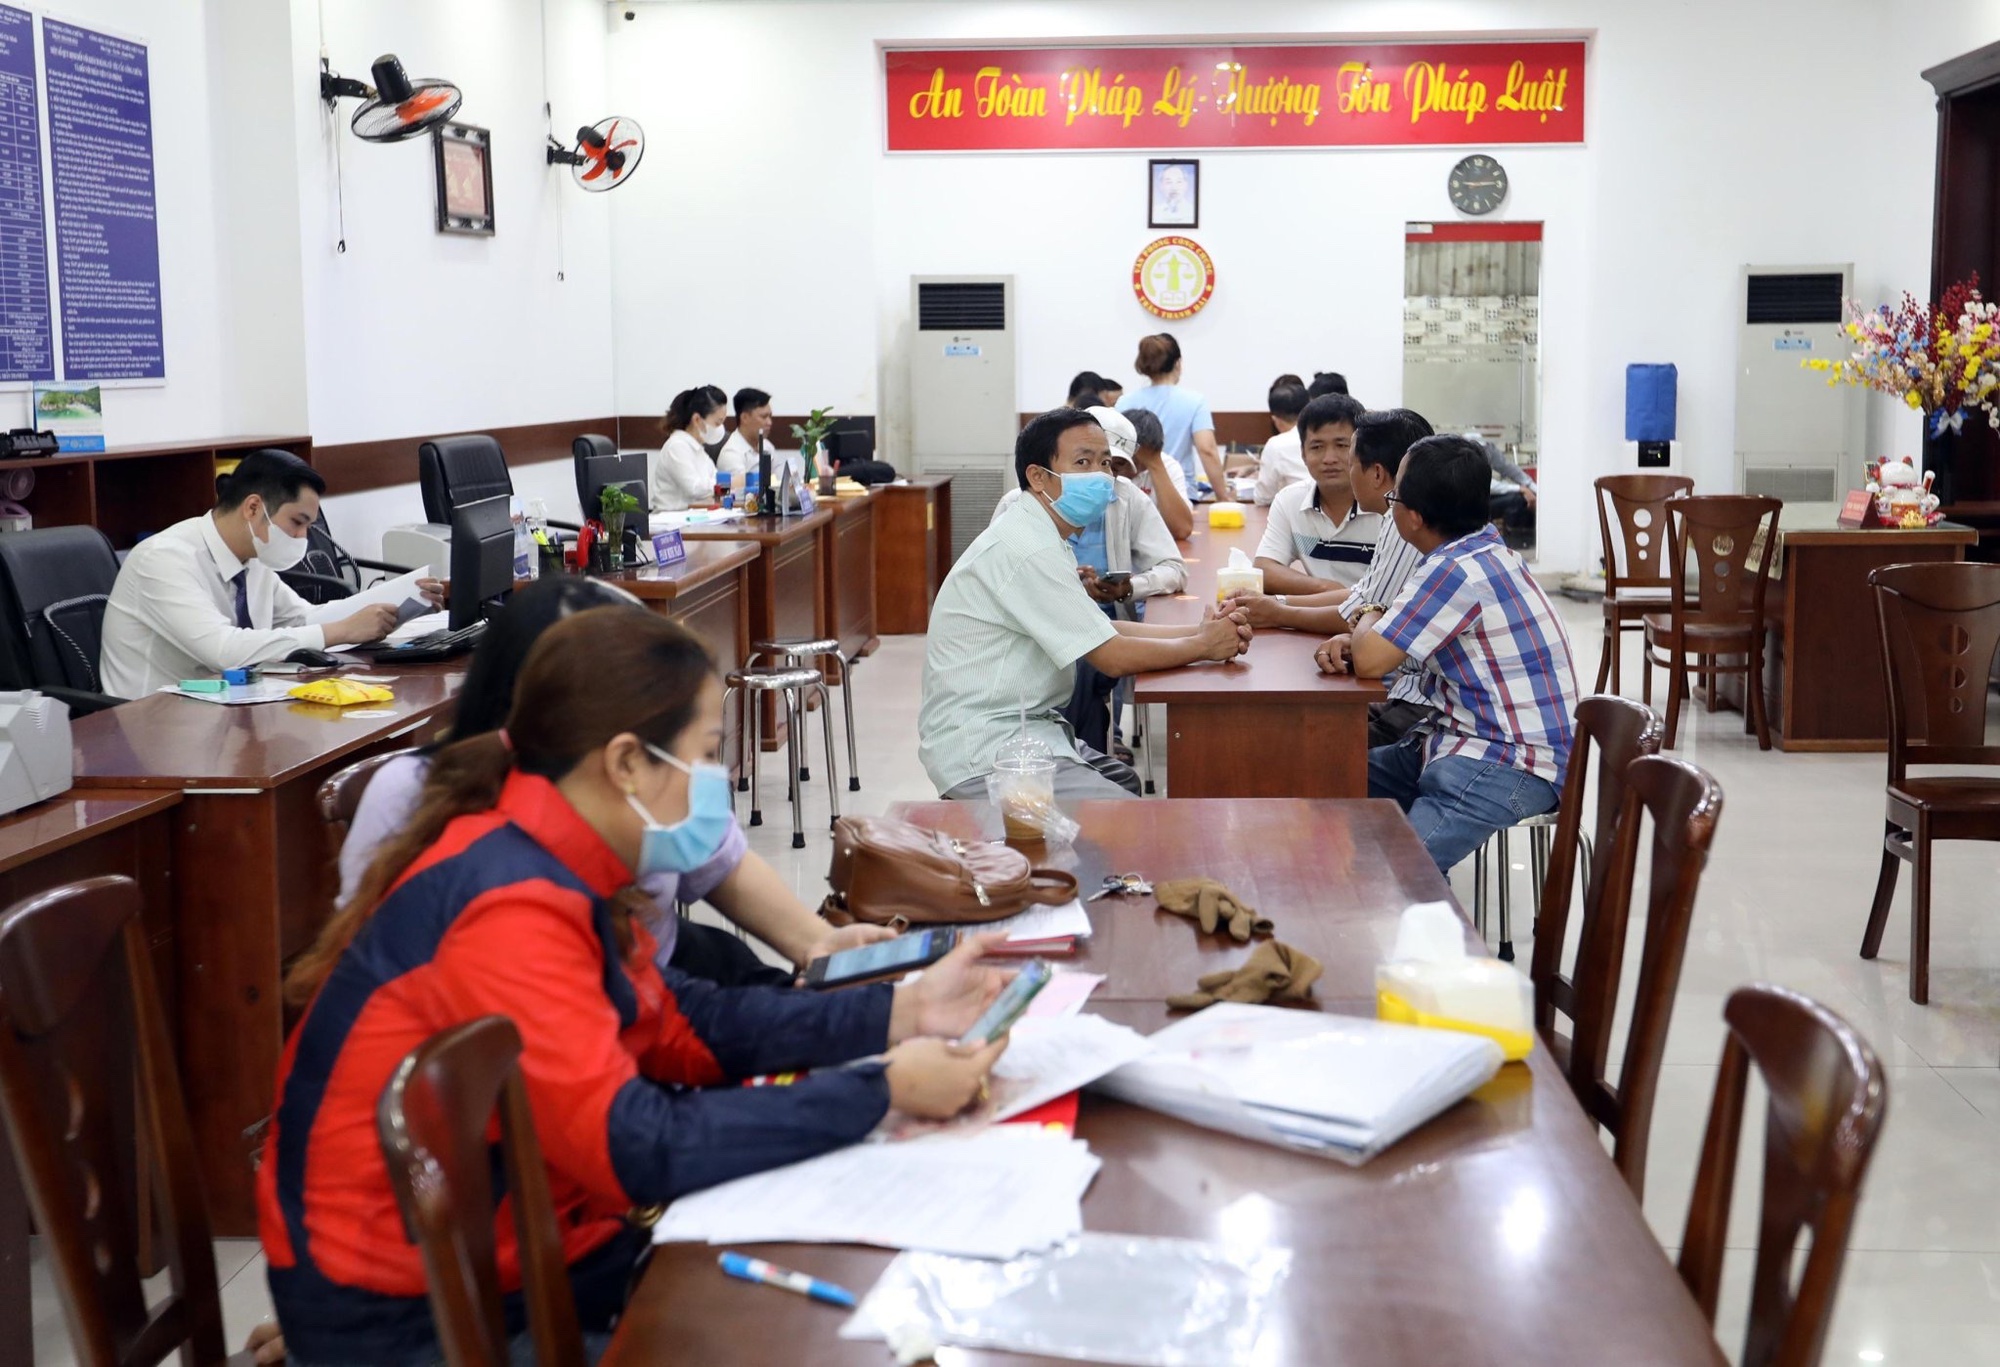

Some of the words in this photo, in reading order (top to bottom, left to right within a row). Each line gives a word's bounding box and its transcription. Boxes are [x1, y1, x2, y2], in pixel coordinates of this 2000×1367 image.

[909, 67, 964, 118] An
[974, 66, 1048, 118] Toàn
[1403, 61, 1489, 125] Pháp
[1495, 59, 1568, 124] Luật
